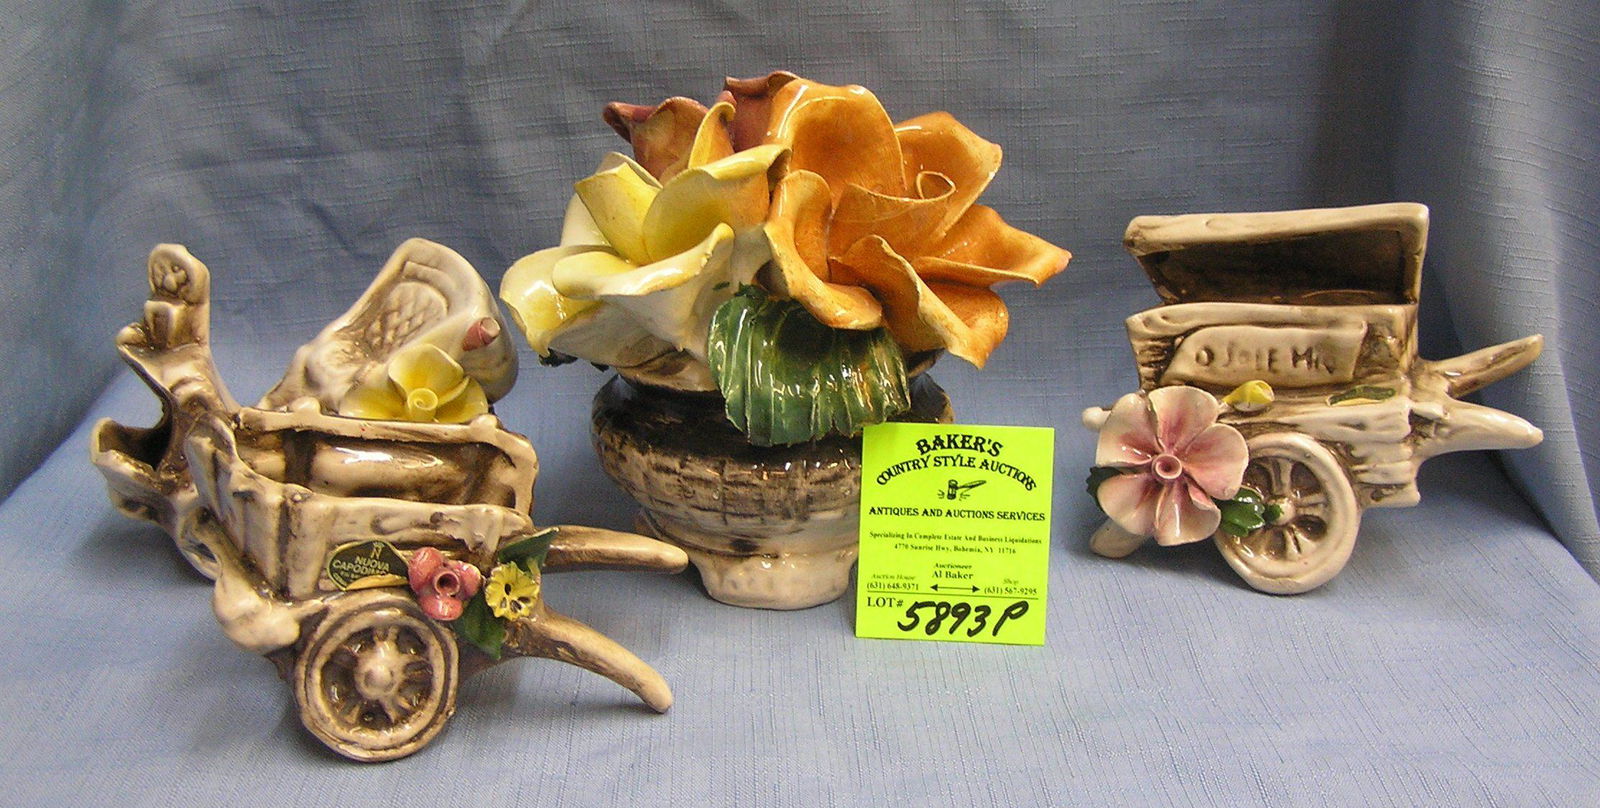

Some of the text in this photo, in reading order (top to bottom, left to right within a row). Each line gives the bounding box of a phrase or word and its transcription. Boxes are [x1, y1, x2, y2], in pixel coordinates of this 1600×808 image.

[916, 433, 1004, 457] BAKER'S
[876, 453, 1037, 492] COUNTRY STYLE AUCTIONS
[869, 507, 1045, 521] ANTIQUES AND AUCTIONS SERVICES
[869, 531, 905, 539] Specializing
[914, 532, 942, 541] Complete
[355, 556, 390, 571] NUOVA
[932, 570, 973, 579] Al Baker
[867, 597, 904, 608] LOT#
[897, 600, 1029, 637] 5893 P
